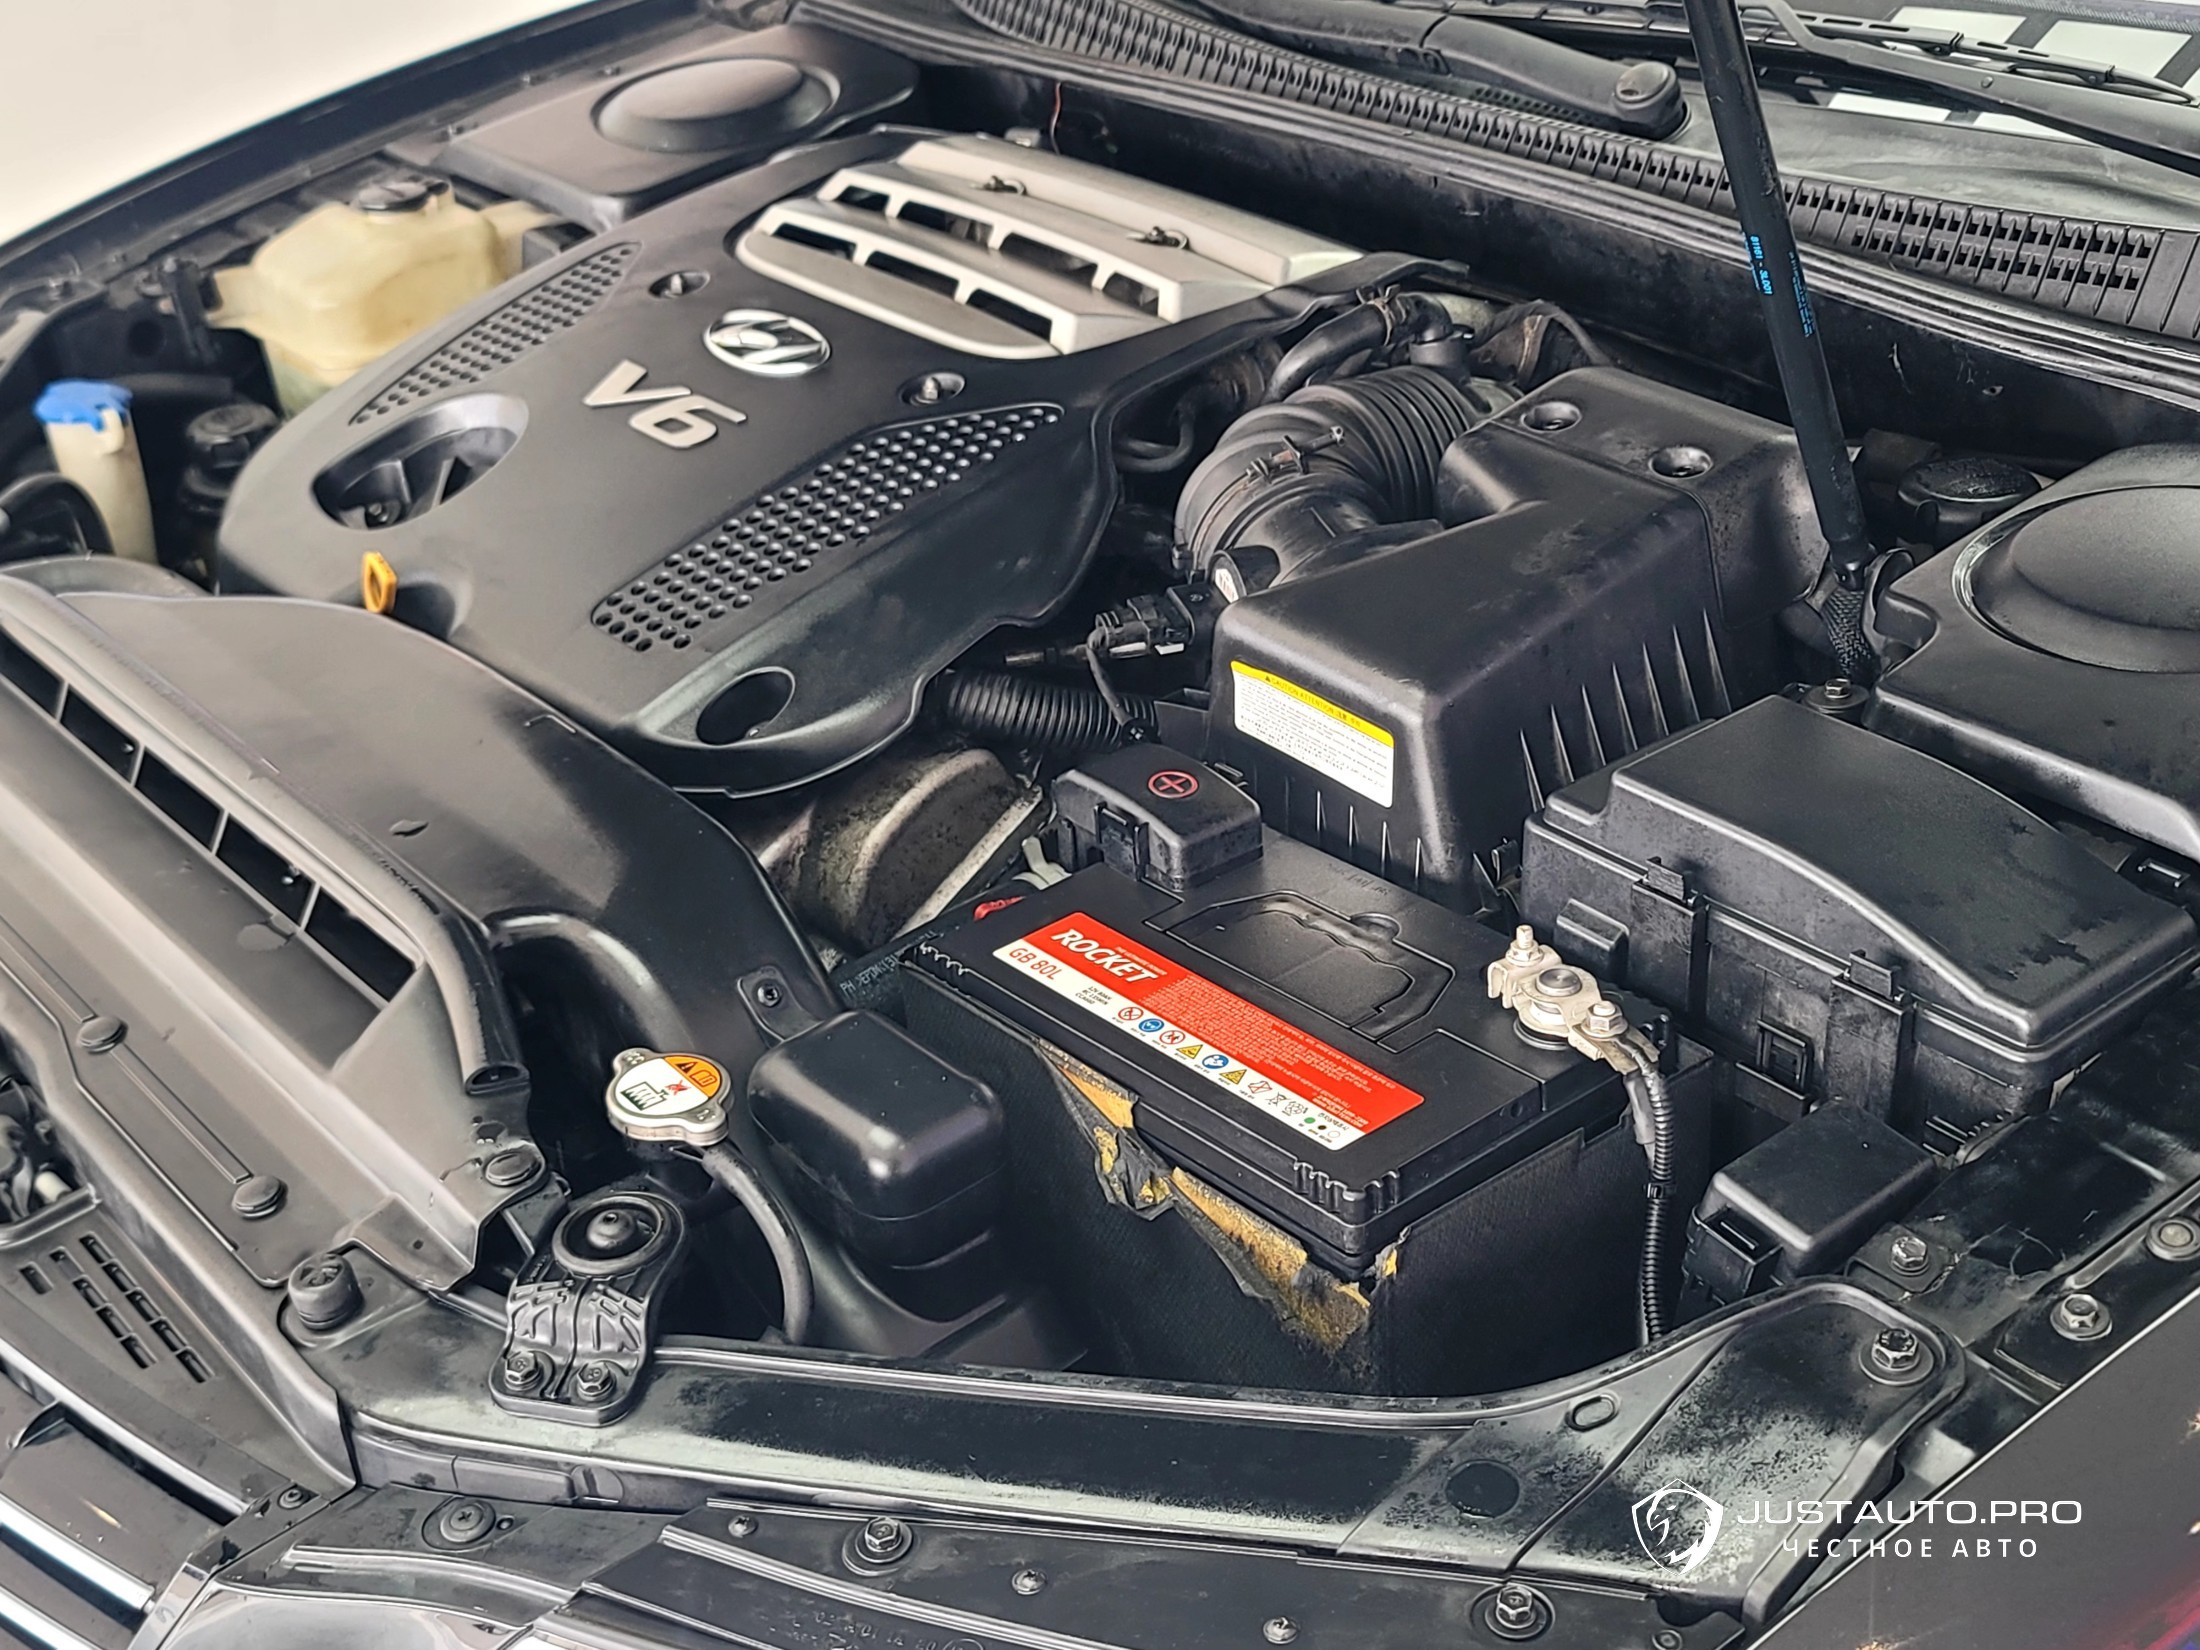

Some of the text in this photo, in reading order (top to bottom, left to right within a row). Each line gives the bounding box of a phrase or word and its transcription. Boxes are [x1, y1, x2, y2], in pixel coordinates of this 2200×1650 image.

[582, 359, 747, 449] V6
[1009, 947, 1062, 980] GB 80L
[1050, 928, 1159, 982] ROCKET
